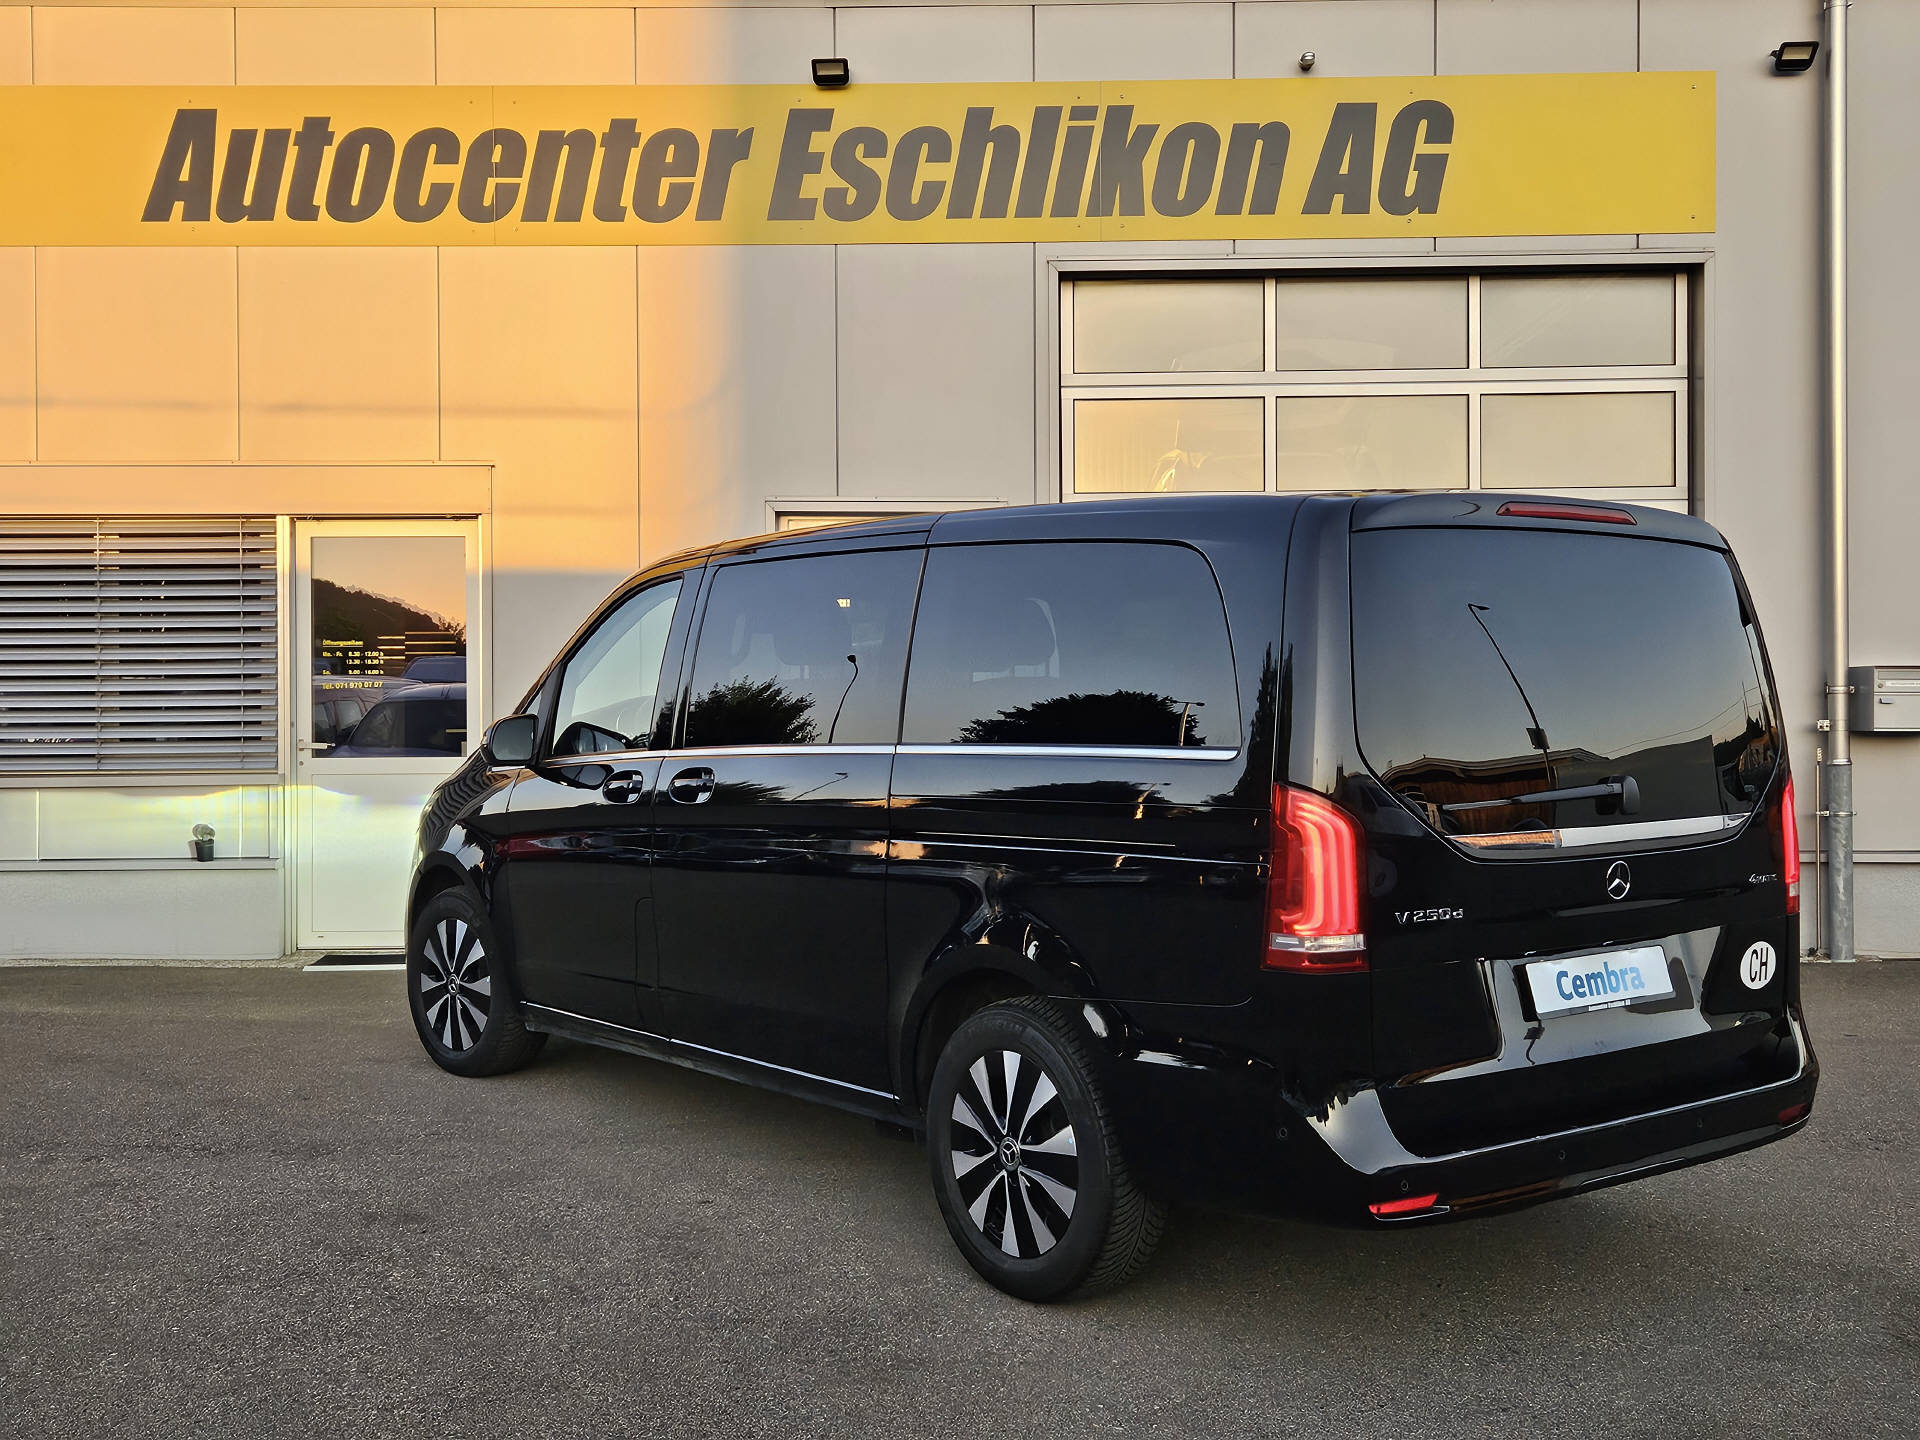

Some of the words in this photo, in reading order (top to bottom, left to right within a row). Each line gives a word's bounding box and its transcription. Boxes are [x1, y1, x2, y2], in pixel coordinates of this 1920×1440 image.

[141, 108, 755, 224] Autocenter
[767, 104, 1291, 222] Eschlikon
[1301, 99, 1455, 216] AG
[322, 682, 335, 690] Tel.
[349, 681, 363, 689] 970
[1394, 911, 1411, 925] V
[1413, 907, 1464, 923] 250d
[1555, 961, 1646, 1001] Cembra
[1749, 946, 1769, 983] CH
